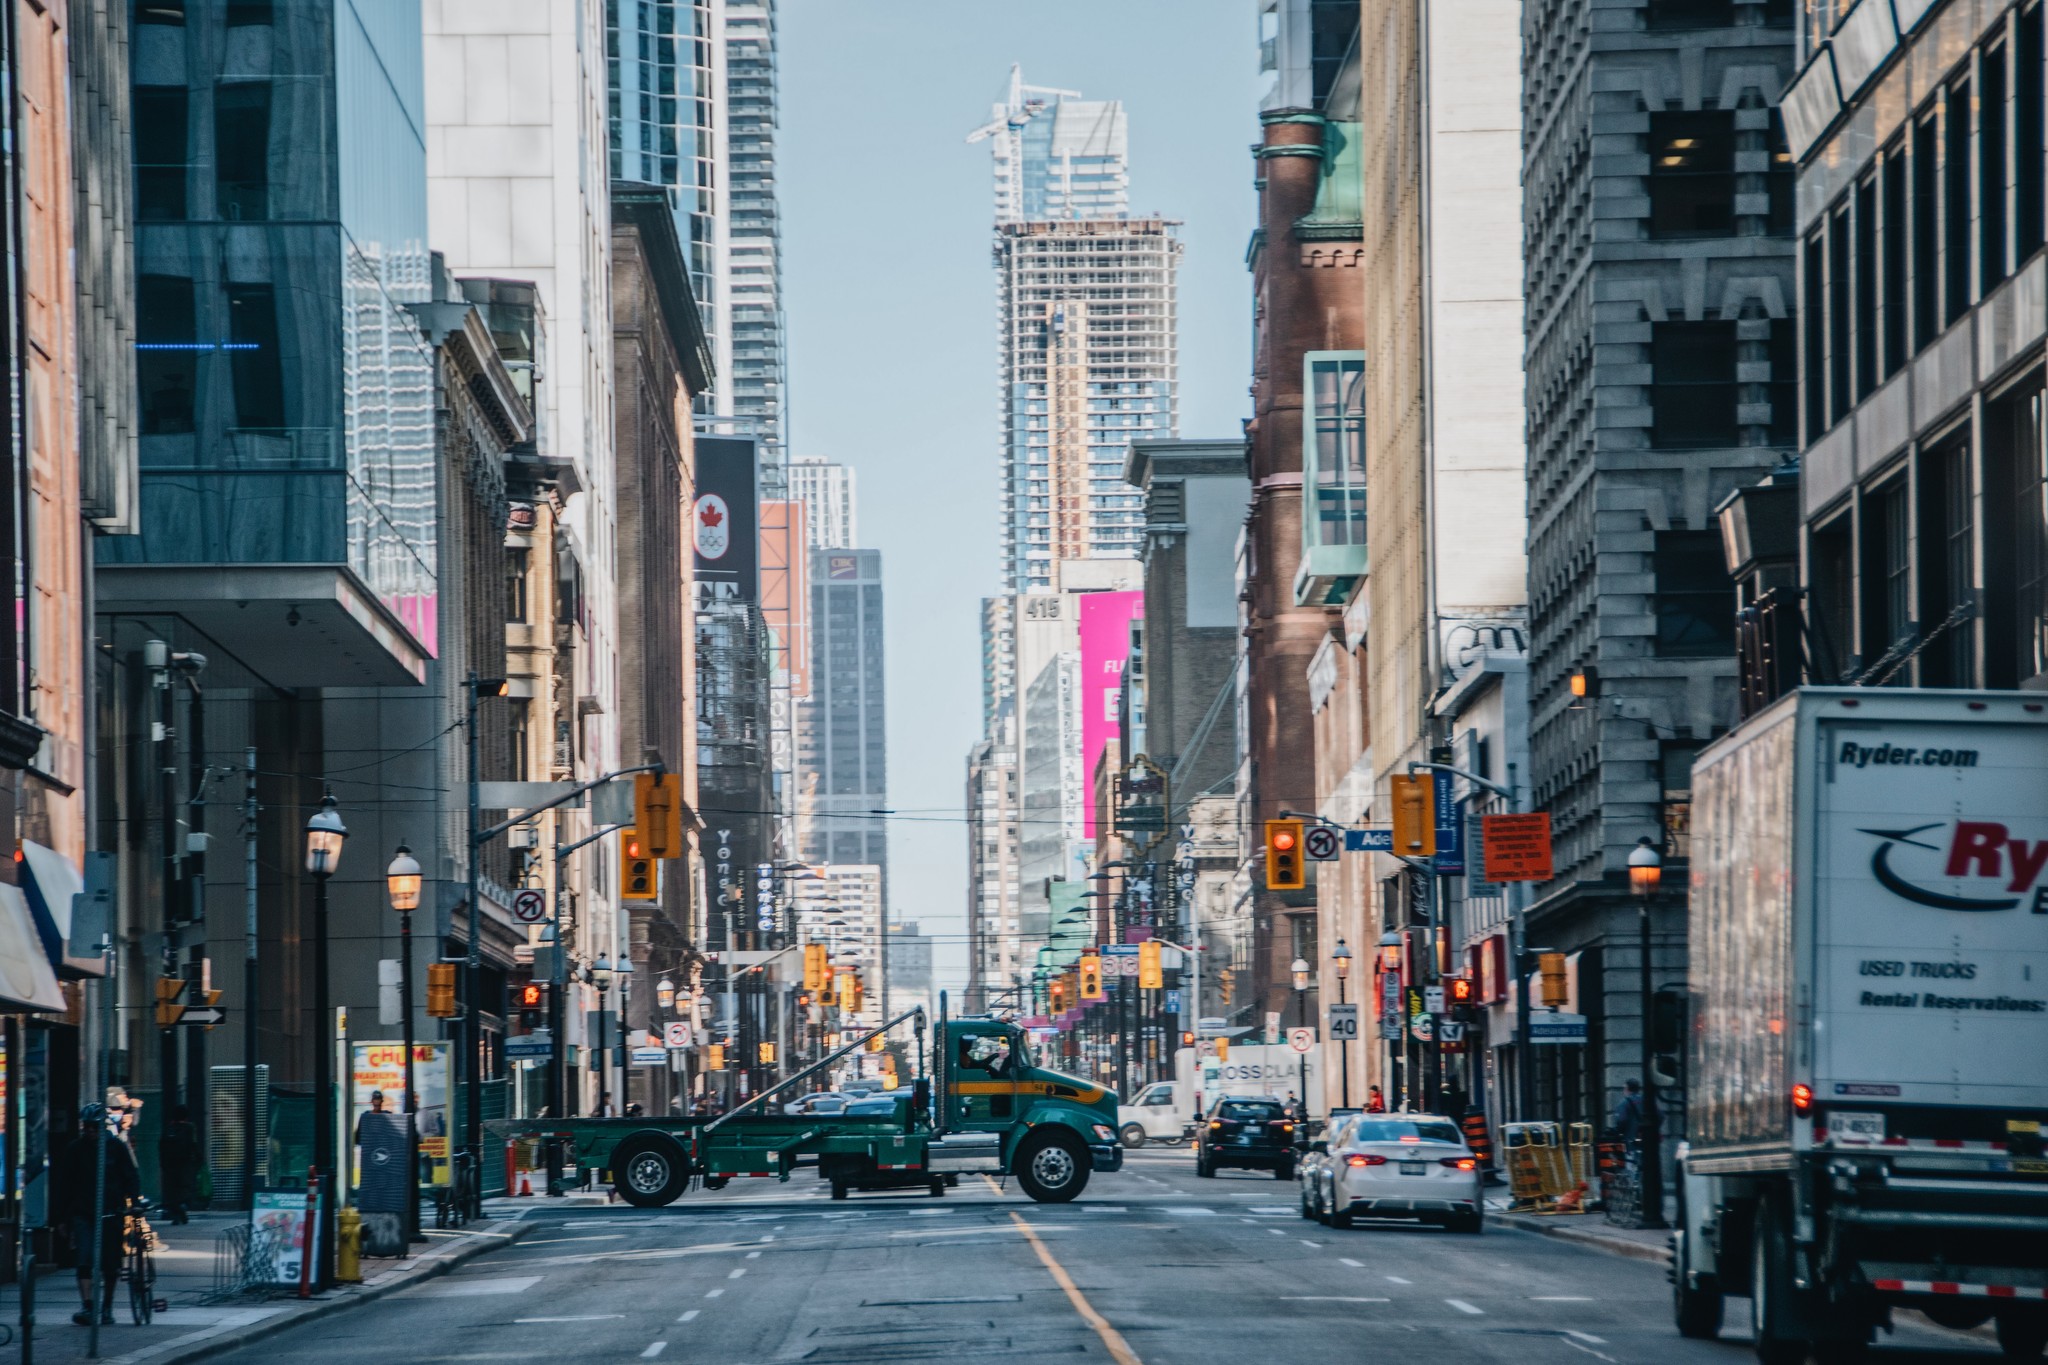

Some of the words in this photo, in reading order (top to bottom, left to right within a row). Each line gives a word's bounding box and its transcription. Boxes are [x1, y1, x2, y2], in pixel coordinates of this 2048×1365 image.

[1026, 598, 1061, 619] 415
[1839, 741, 1978, 768] Ryder.com
[1361, 832, 1392, 846] Ade
[1168, 865, 1177, 921] DOWNTOWN
[1859, 961, 1904, 976] USED
[1910, 962, 1977, 979] TRUCKS
[1860, 991, 1918, 1008] Rental
[1923, 993, 2047, 1012] Reservations:
[1332, 1019, 1356, 1035] 40
[1220, 1064, 1314, 1080] OSSCLAR
